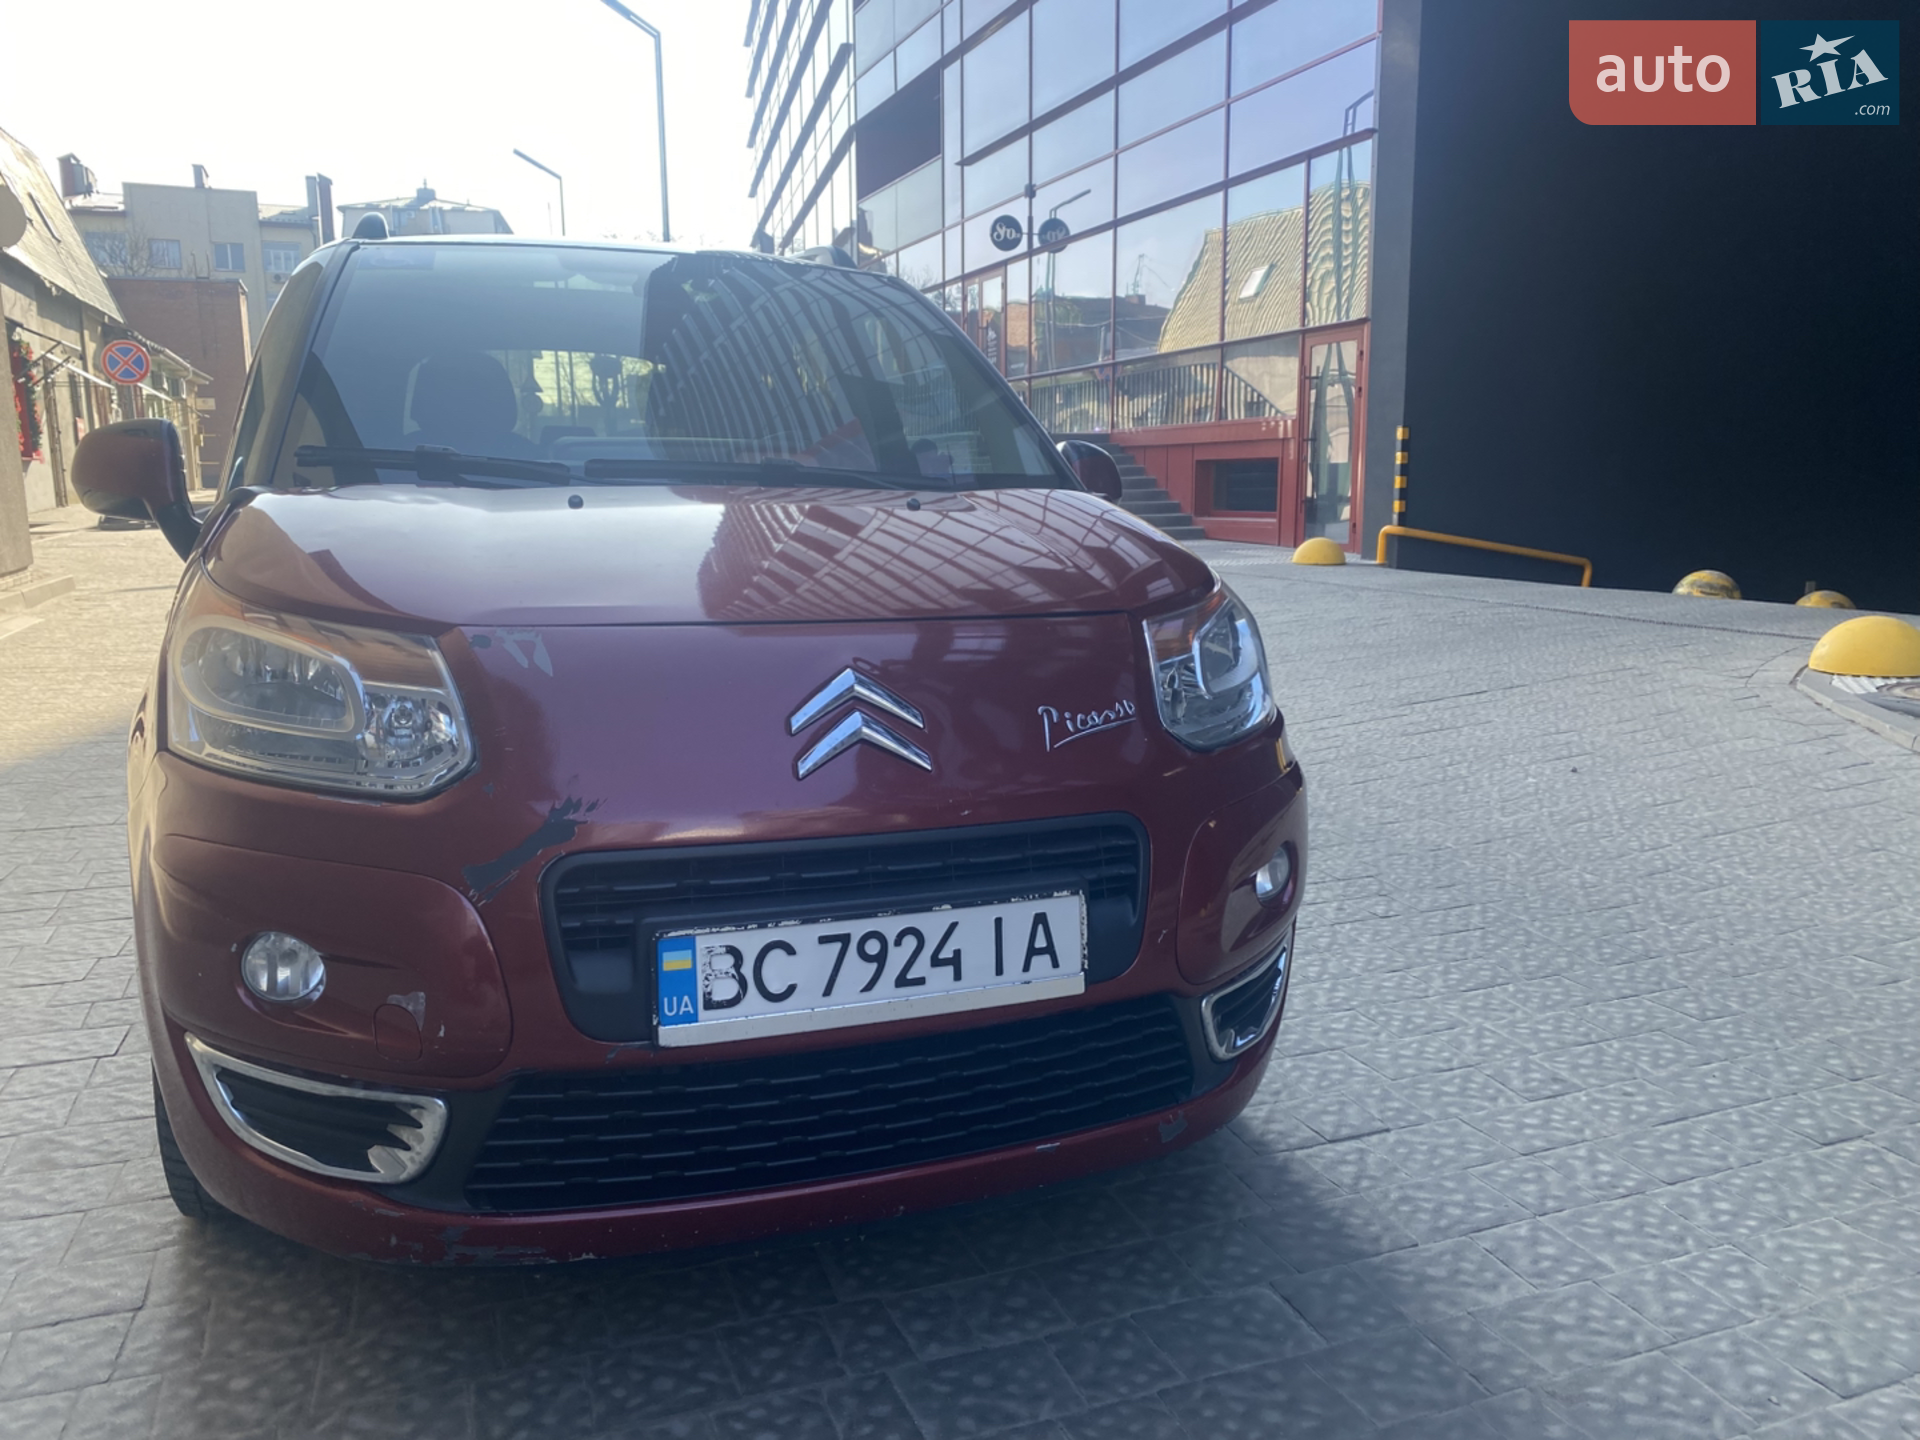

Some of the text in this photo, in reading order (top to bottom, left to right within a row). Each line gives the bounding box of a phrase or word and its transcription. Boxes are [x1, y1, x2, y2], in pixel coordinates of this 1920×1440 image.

[702, 912, 1060, 1011] BC 7924 IA
[663, 994, 694, 1017] UA
